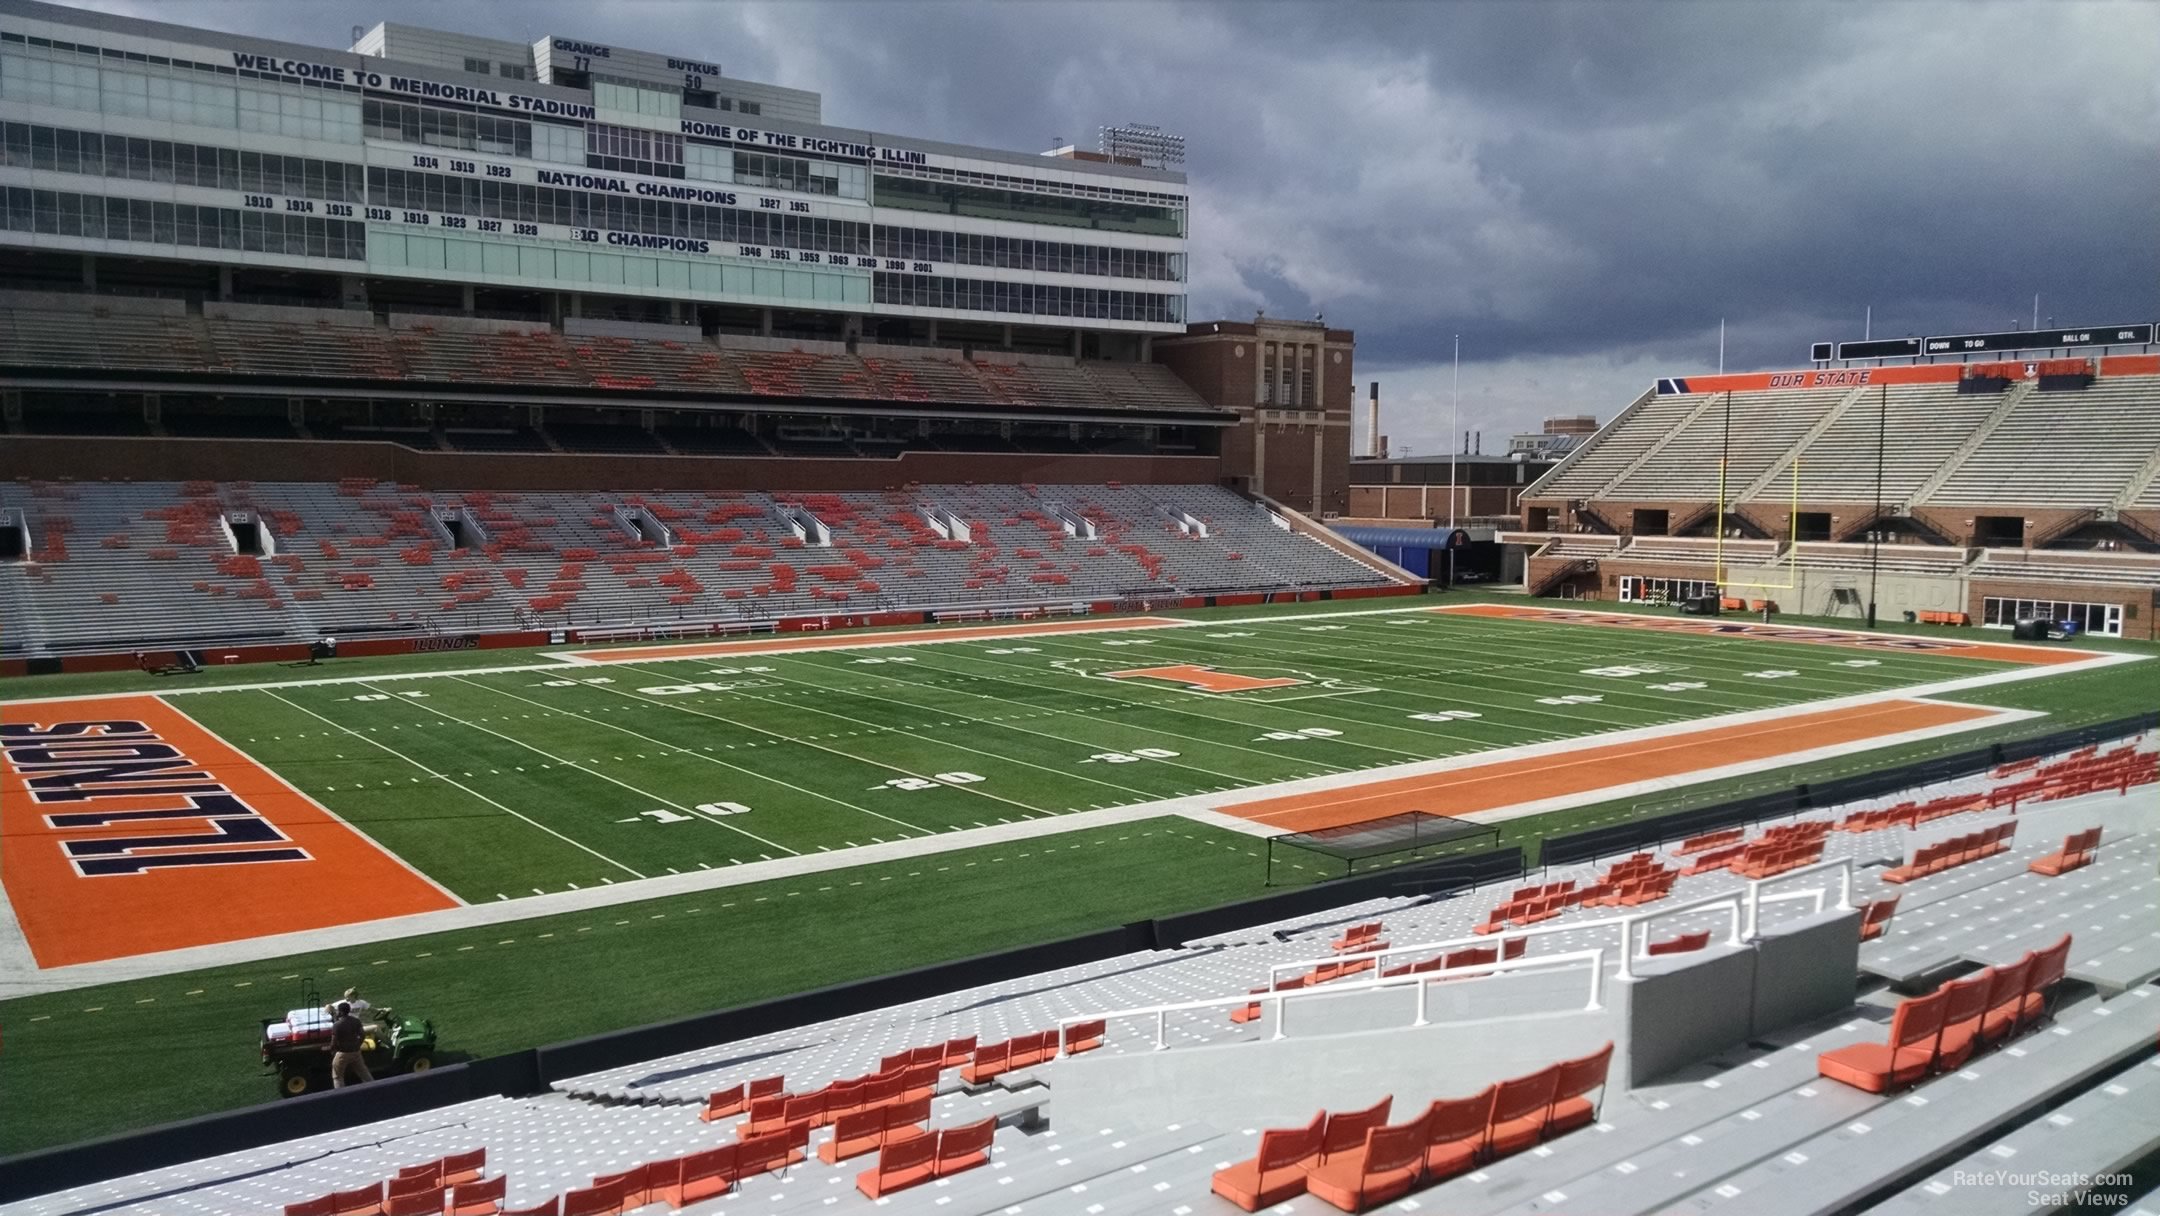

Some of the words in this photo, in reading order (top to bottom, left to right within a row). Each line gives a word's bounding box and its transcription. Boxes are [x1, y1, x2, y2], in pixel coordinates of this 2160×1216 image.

[553, 39, 610, 58] GRANGE
[574, 56, 590, 71] 77
[667, 58, 719, 76] BUTKUS
[233, 53, 345, 82] WELCOME
[352, 70, 382, 88] TO
[390, 76, 501, 106] MEMORIAL
[508, 95, 596, 120] STADIUM
[685, 74, 702, 89] 50
[681, 120, 731, 139] HOME
[737, 129, 759, 142] OF
[764, 131, 797, 148] THE
[802, 137, 876, 159] FIGHTING
[881, 148, 926, 165] ILLINI
[413, 155, 439, 169] 1914
[450, 160, 475, 174] 1919
[486, 164, 511, 178] 1923
[537, 170, 630, 194] NATIONAL
[636, 182, 737, 205] CHAMPIONS
[759, 197, 781, 210] 1927
[789, 201, 810, 213] 1951
[244, 195, 273, 209] 1910
[286, 199, 314, 213] 1914
[326, 203, 353, 217] 1915
[364, 207, 391, 221] 1918
[403, 211, 429, 225] 1919
[440, 215, 466, 229] 1923
[477, 219, 502, 232] 1927
[513, 223, 538, 236] 1928
[607, 232, 709, 253] CHAMPIONS
[770, 249, 791, 260] 1951
[799, 252, 820, 263] 1953
[913, 262, 933, 273] 2001
[1929, 341, 1950, 350] DOWN
[1964, 340, 1974, 348] TO
[2063, 334, 2079, 342] BALL
[2080, 333, 2090, 341] ON
[1769, 374, 1805, 388] OUR
[1814, 370, 1871, 386] STATE
[412, 636, 480, 651] ILLINOIS
[1089, 747, 1182, 764] 30
[885, 771, 988, 792] 20
[639, 801, 753, 825] 10
